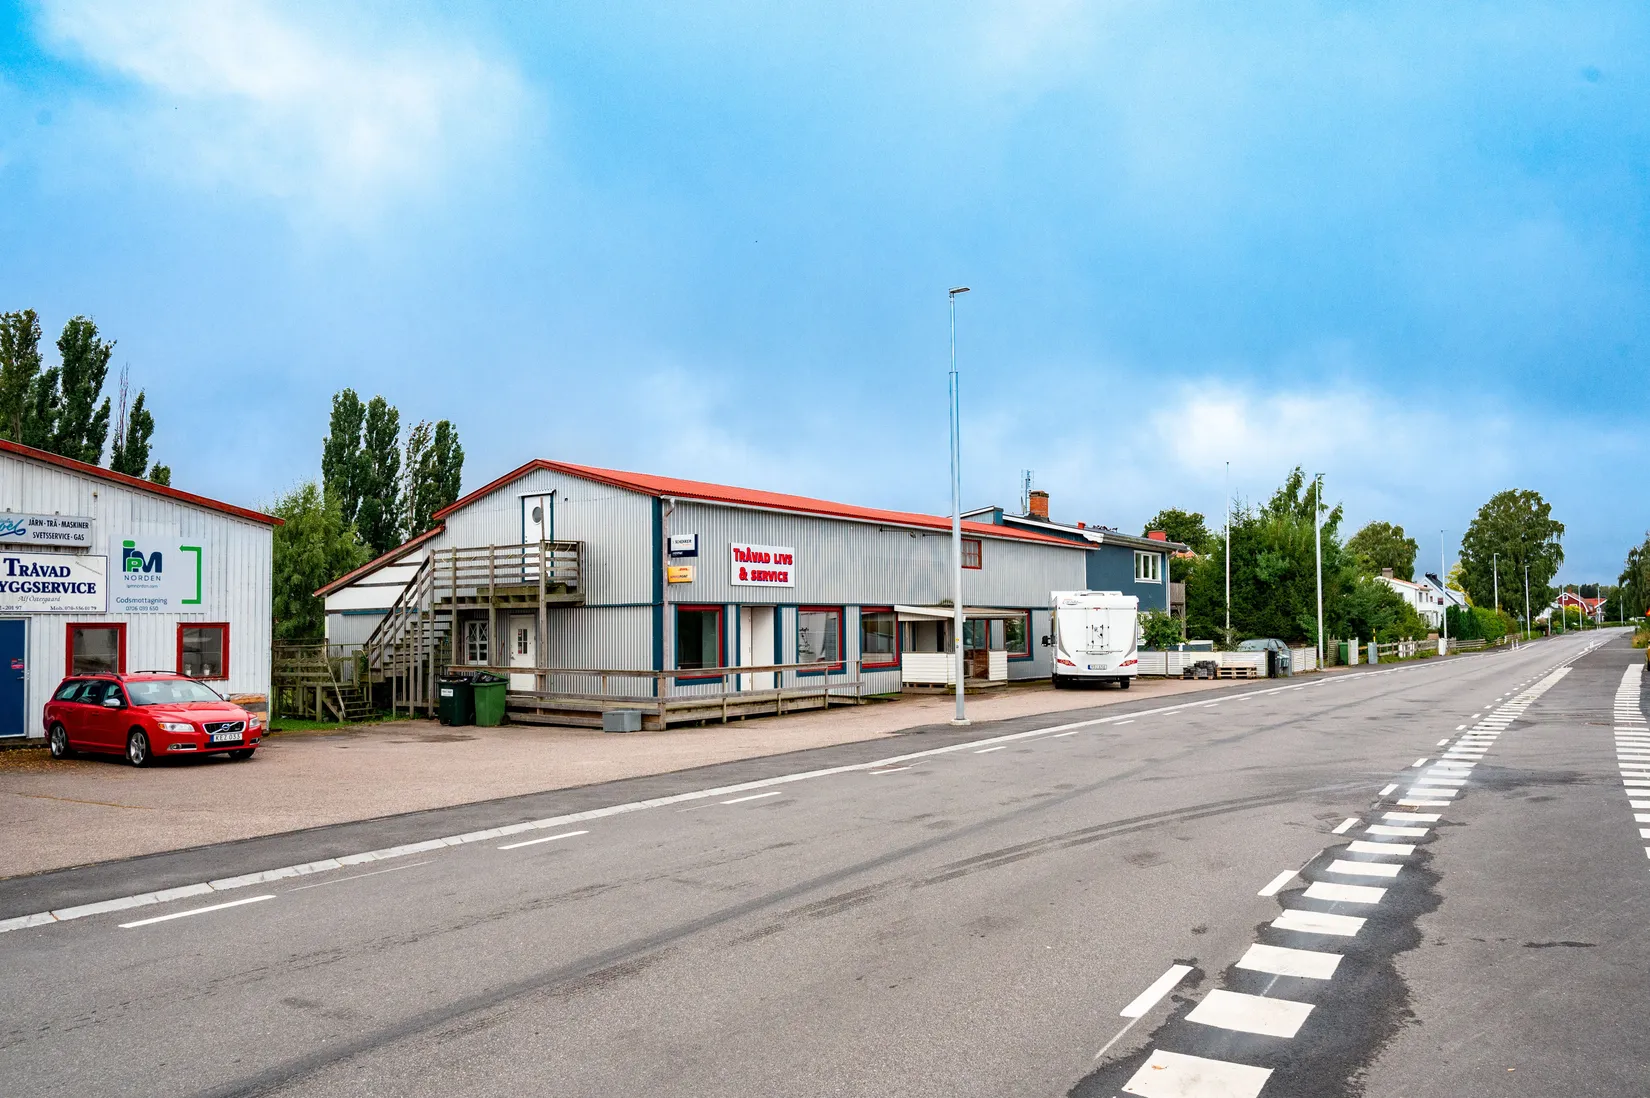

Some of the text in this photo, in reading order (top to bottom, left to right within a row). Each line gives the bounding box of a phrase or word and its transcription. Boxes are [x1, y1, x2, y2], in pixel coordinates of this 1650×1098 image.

[28, 517, 89, 529] JÄRN TRÄ MASKINER
[32, 531, 85, 541] SVETSSERVICE GAS
[733, 547, 793, 565] TRÅVAD LIVS
[739, 566, 788, 582] & SERVICE
[115, 597, 168, 605] Godsmottagning
